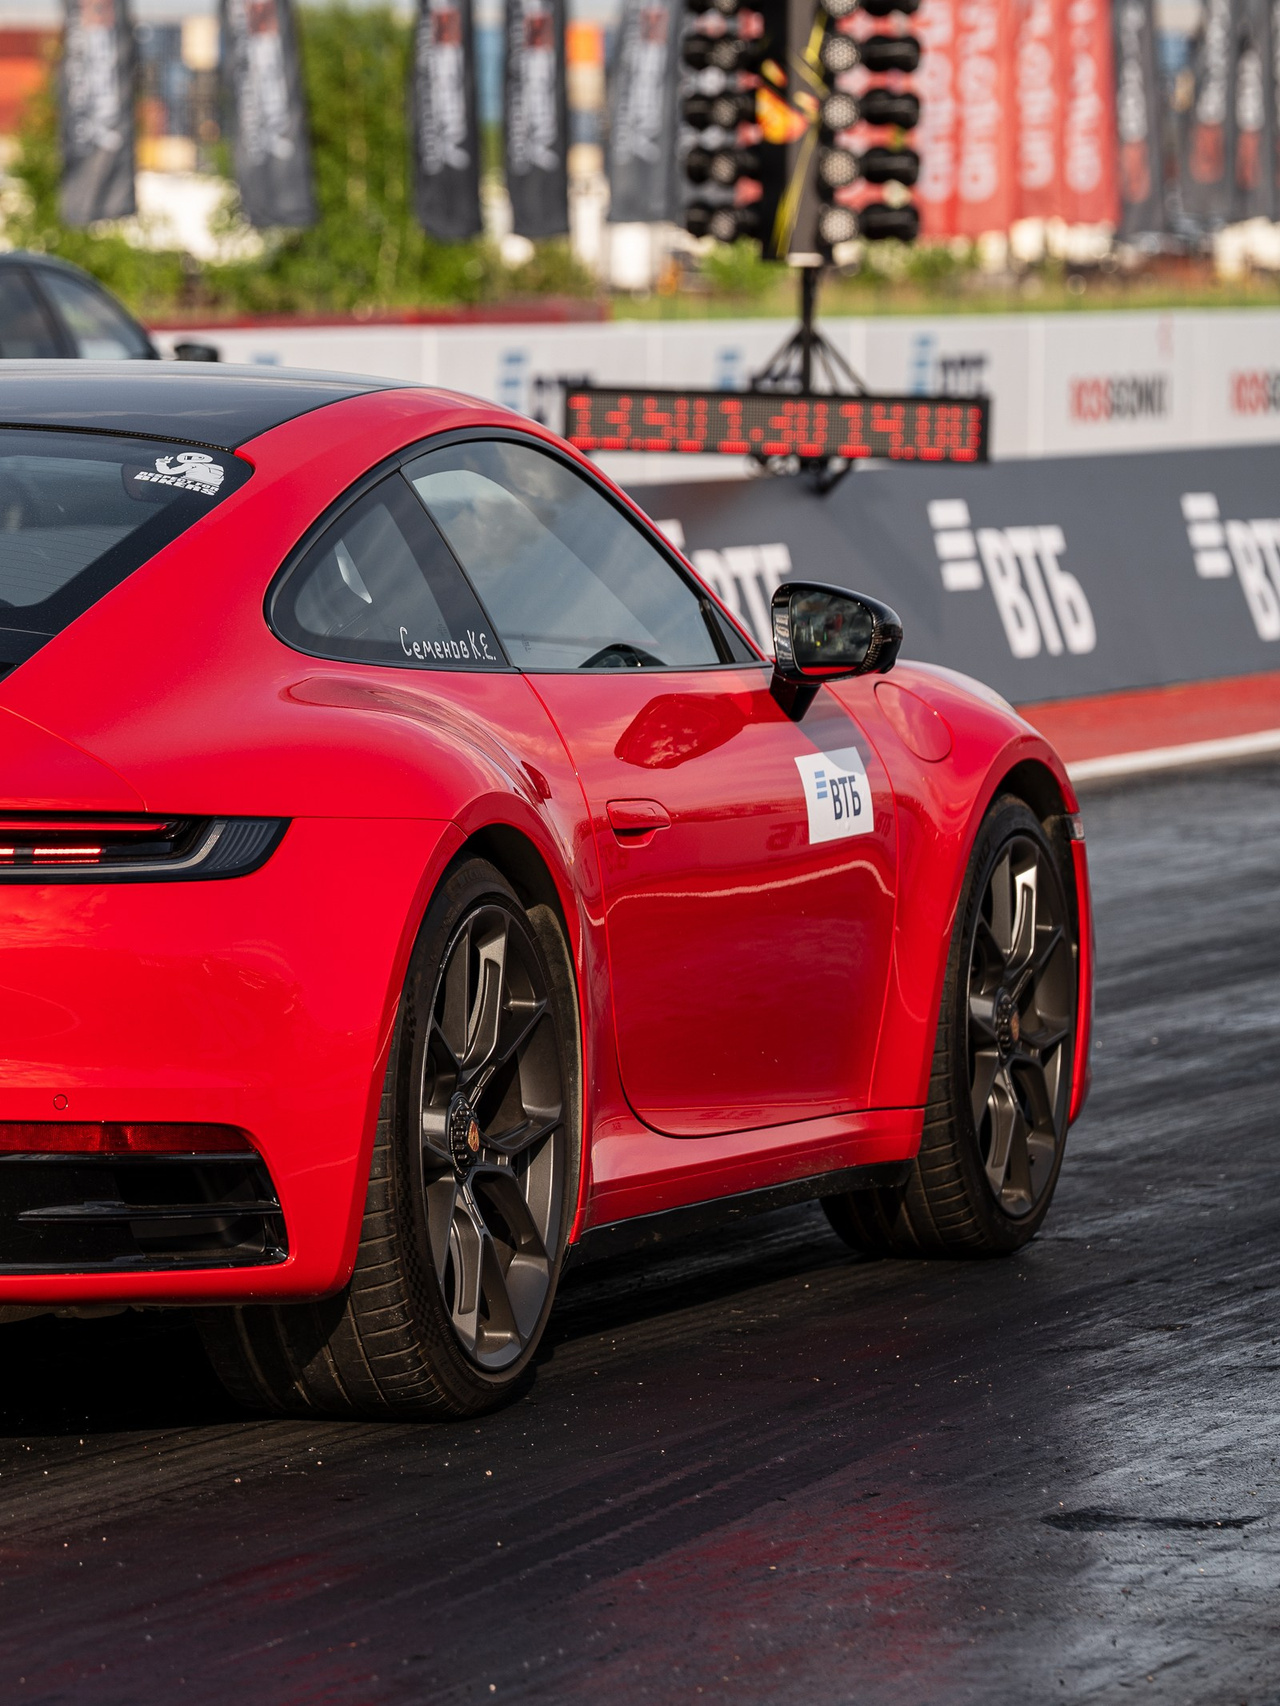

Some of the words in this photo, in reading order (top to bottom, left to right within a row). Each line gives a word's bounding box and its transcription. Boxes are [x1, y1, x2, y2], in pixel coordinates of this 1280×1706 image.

[134, 475, 215, 495] BIKERS
[976, 524, 1097, 658] ВТБ
[829, 775, 862, 820] ВТБ
